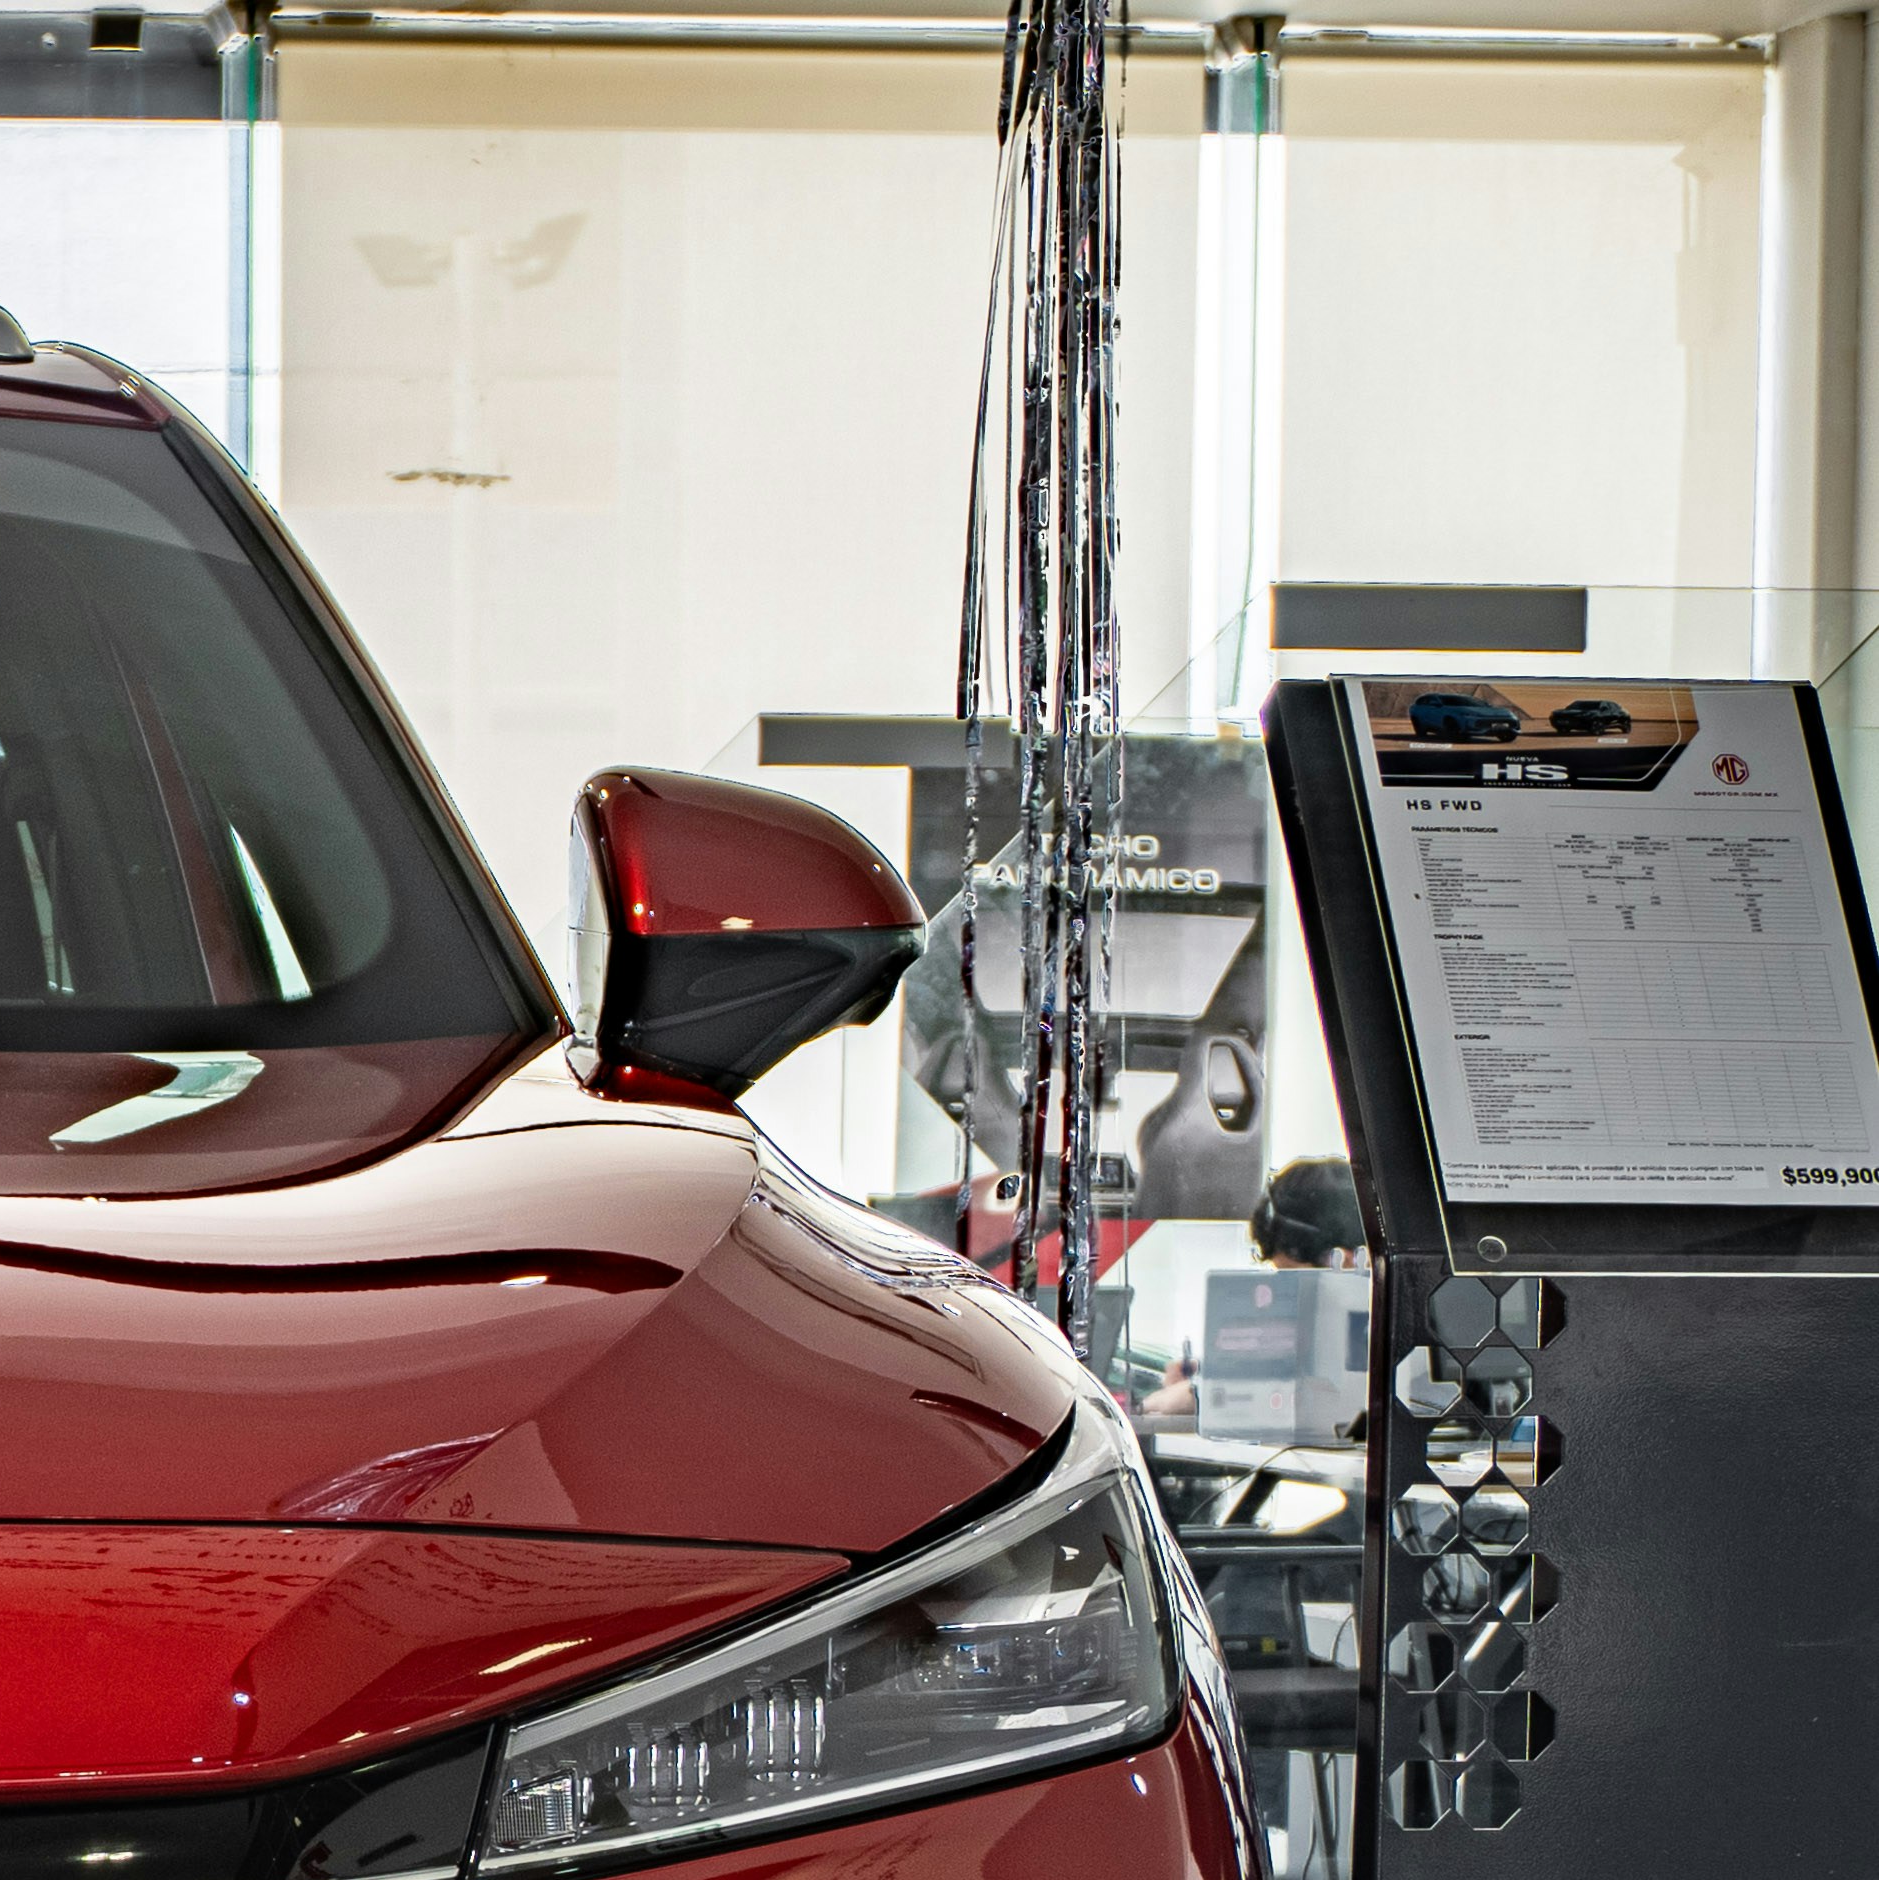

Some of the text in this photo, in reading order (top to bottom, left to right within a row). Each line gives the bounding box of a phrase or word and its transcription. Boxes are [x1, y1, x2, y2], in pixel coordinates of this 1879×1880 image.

[1482, 763, 1569, 781] HS
[1714, 756, 1747, 783] MG
[1406, 800, 1482, 811] HS FWD
[1039, 834, 1161, 859] TCHO
